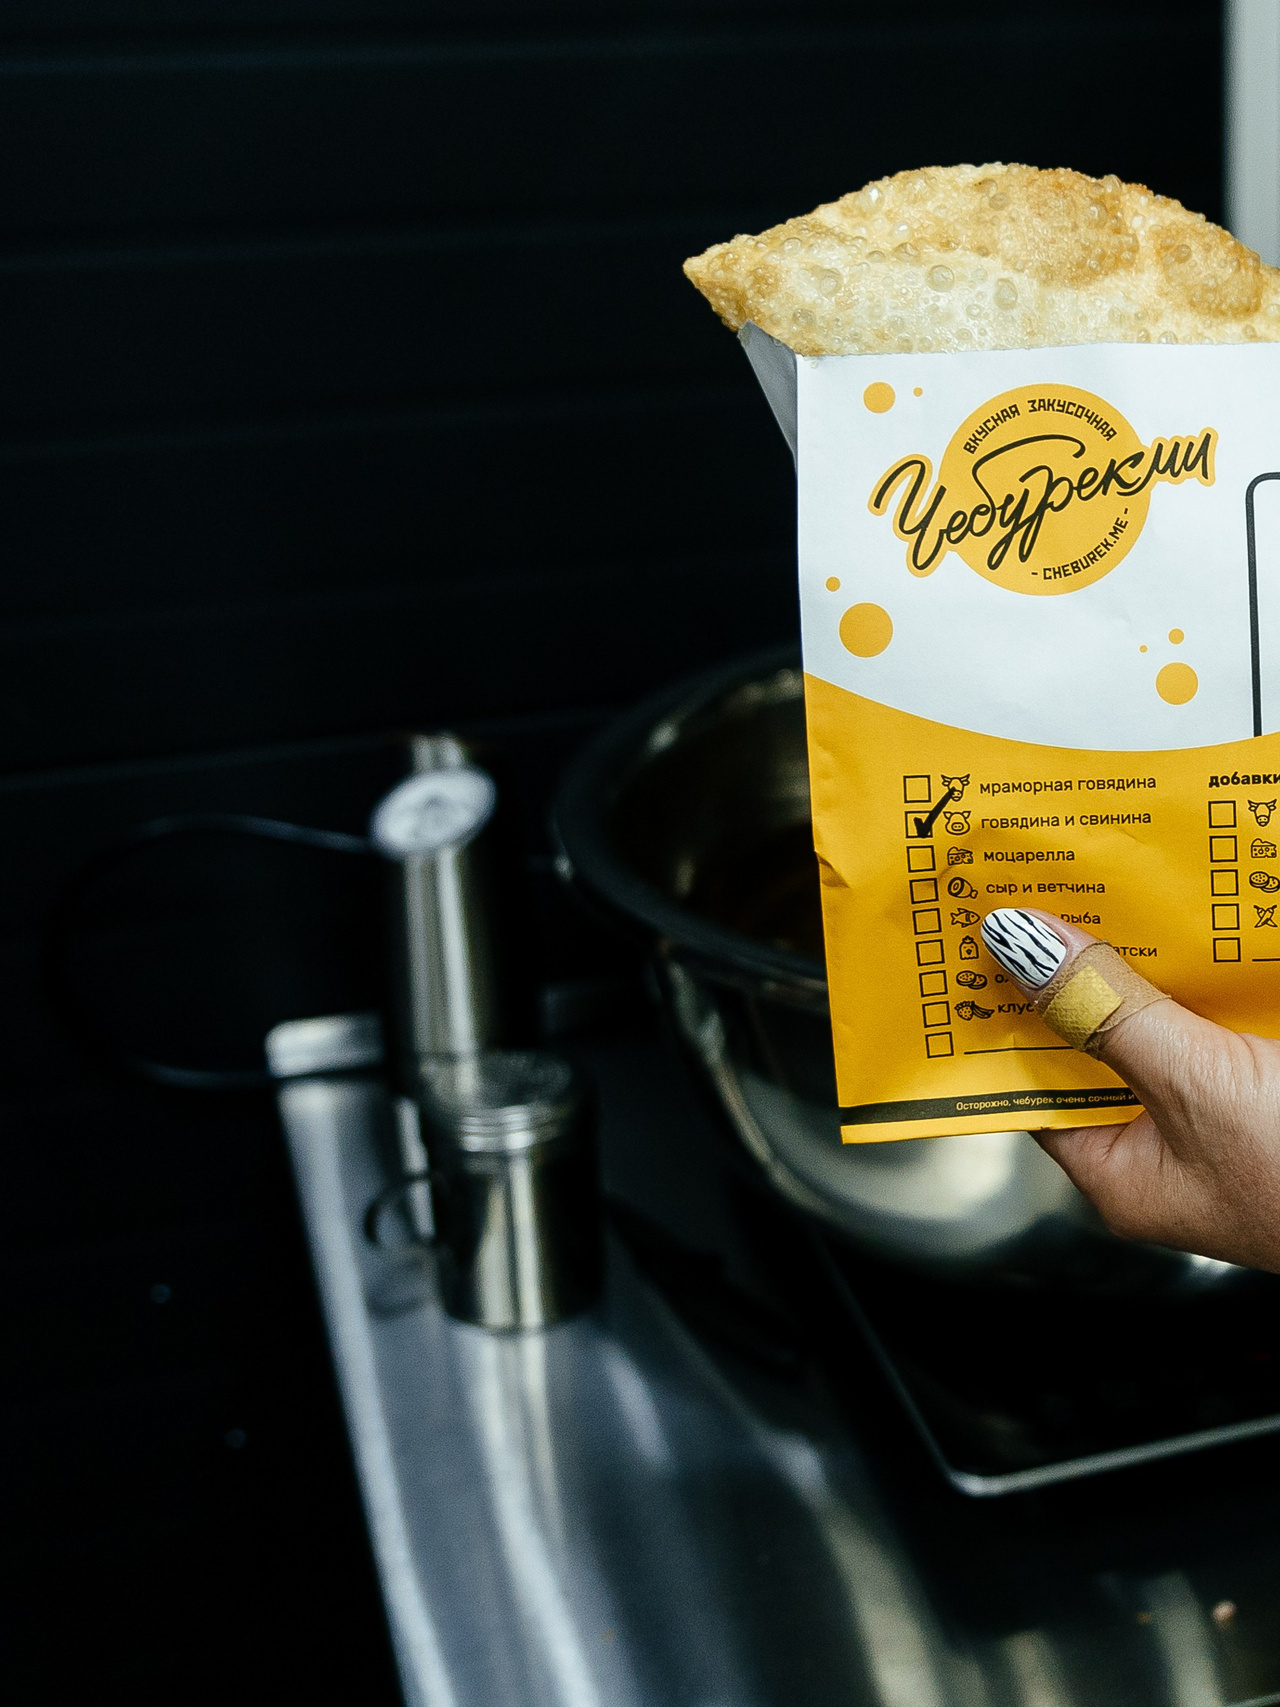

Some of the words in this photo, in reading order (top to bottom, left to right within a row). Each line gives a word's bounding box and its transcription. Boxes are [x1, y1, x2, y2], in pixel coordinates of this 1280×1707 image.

[963, 404, 1020, 455] ВКУСНАЯ
[1027, 398, 1117, 442] ЗАКУСОЧНАЯ
[1043, 517, 1129, 580] CHEBUREK.ME
[979, 779, 1073, 797] мраморная
[1077, 776, 1157, 793] говядина
[981, 815, 1060, 830] говядина
[1063, 814, 1075, 827] и
[1079, 811, 1152, 827] свинина
[983, 849, 1075, 865] моцарелла
[985, 882, 1018, 896] сыр
[1022, 882, 1033, 894] и
[1036, 881, 1106, 894] ветчина
[1060, 911, 1101, 925] рыба
[955, 1097, 1012, 1112] Осторожно,
[1012, 1095, 1054, 1108] чебурек
[1056, 1096, 1086, 1104] очень
[1088, 1092, 1126, 1102] сочный
